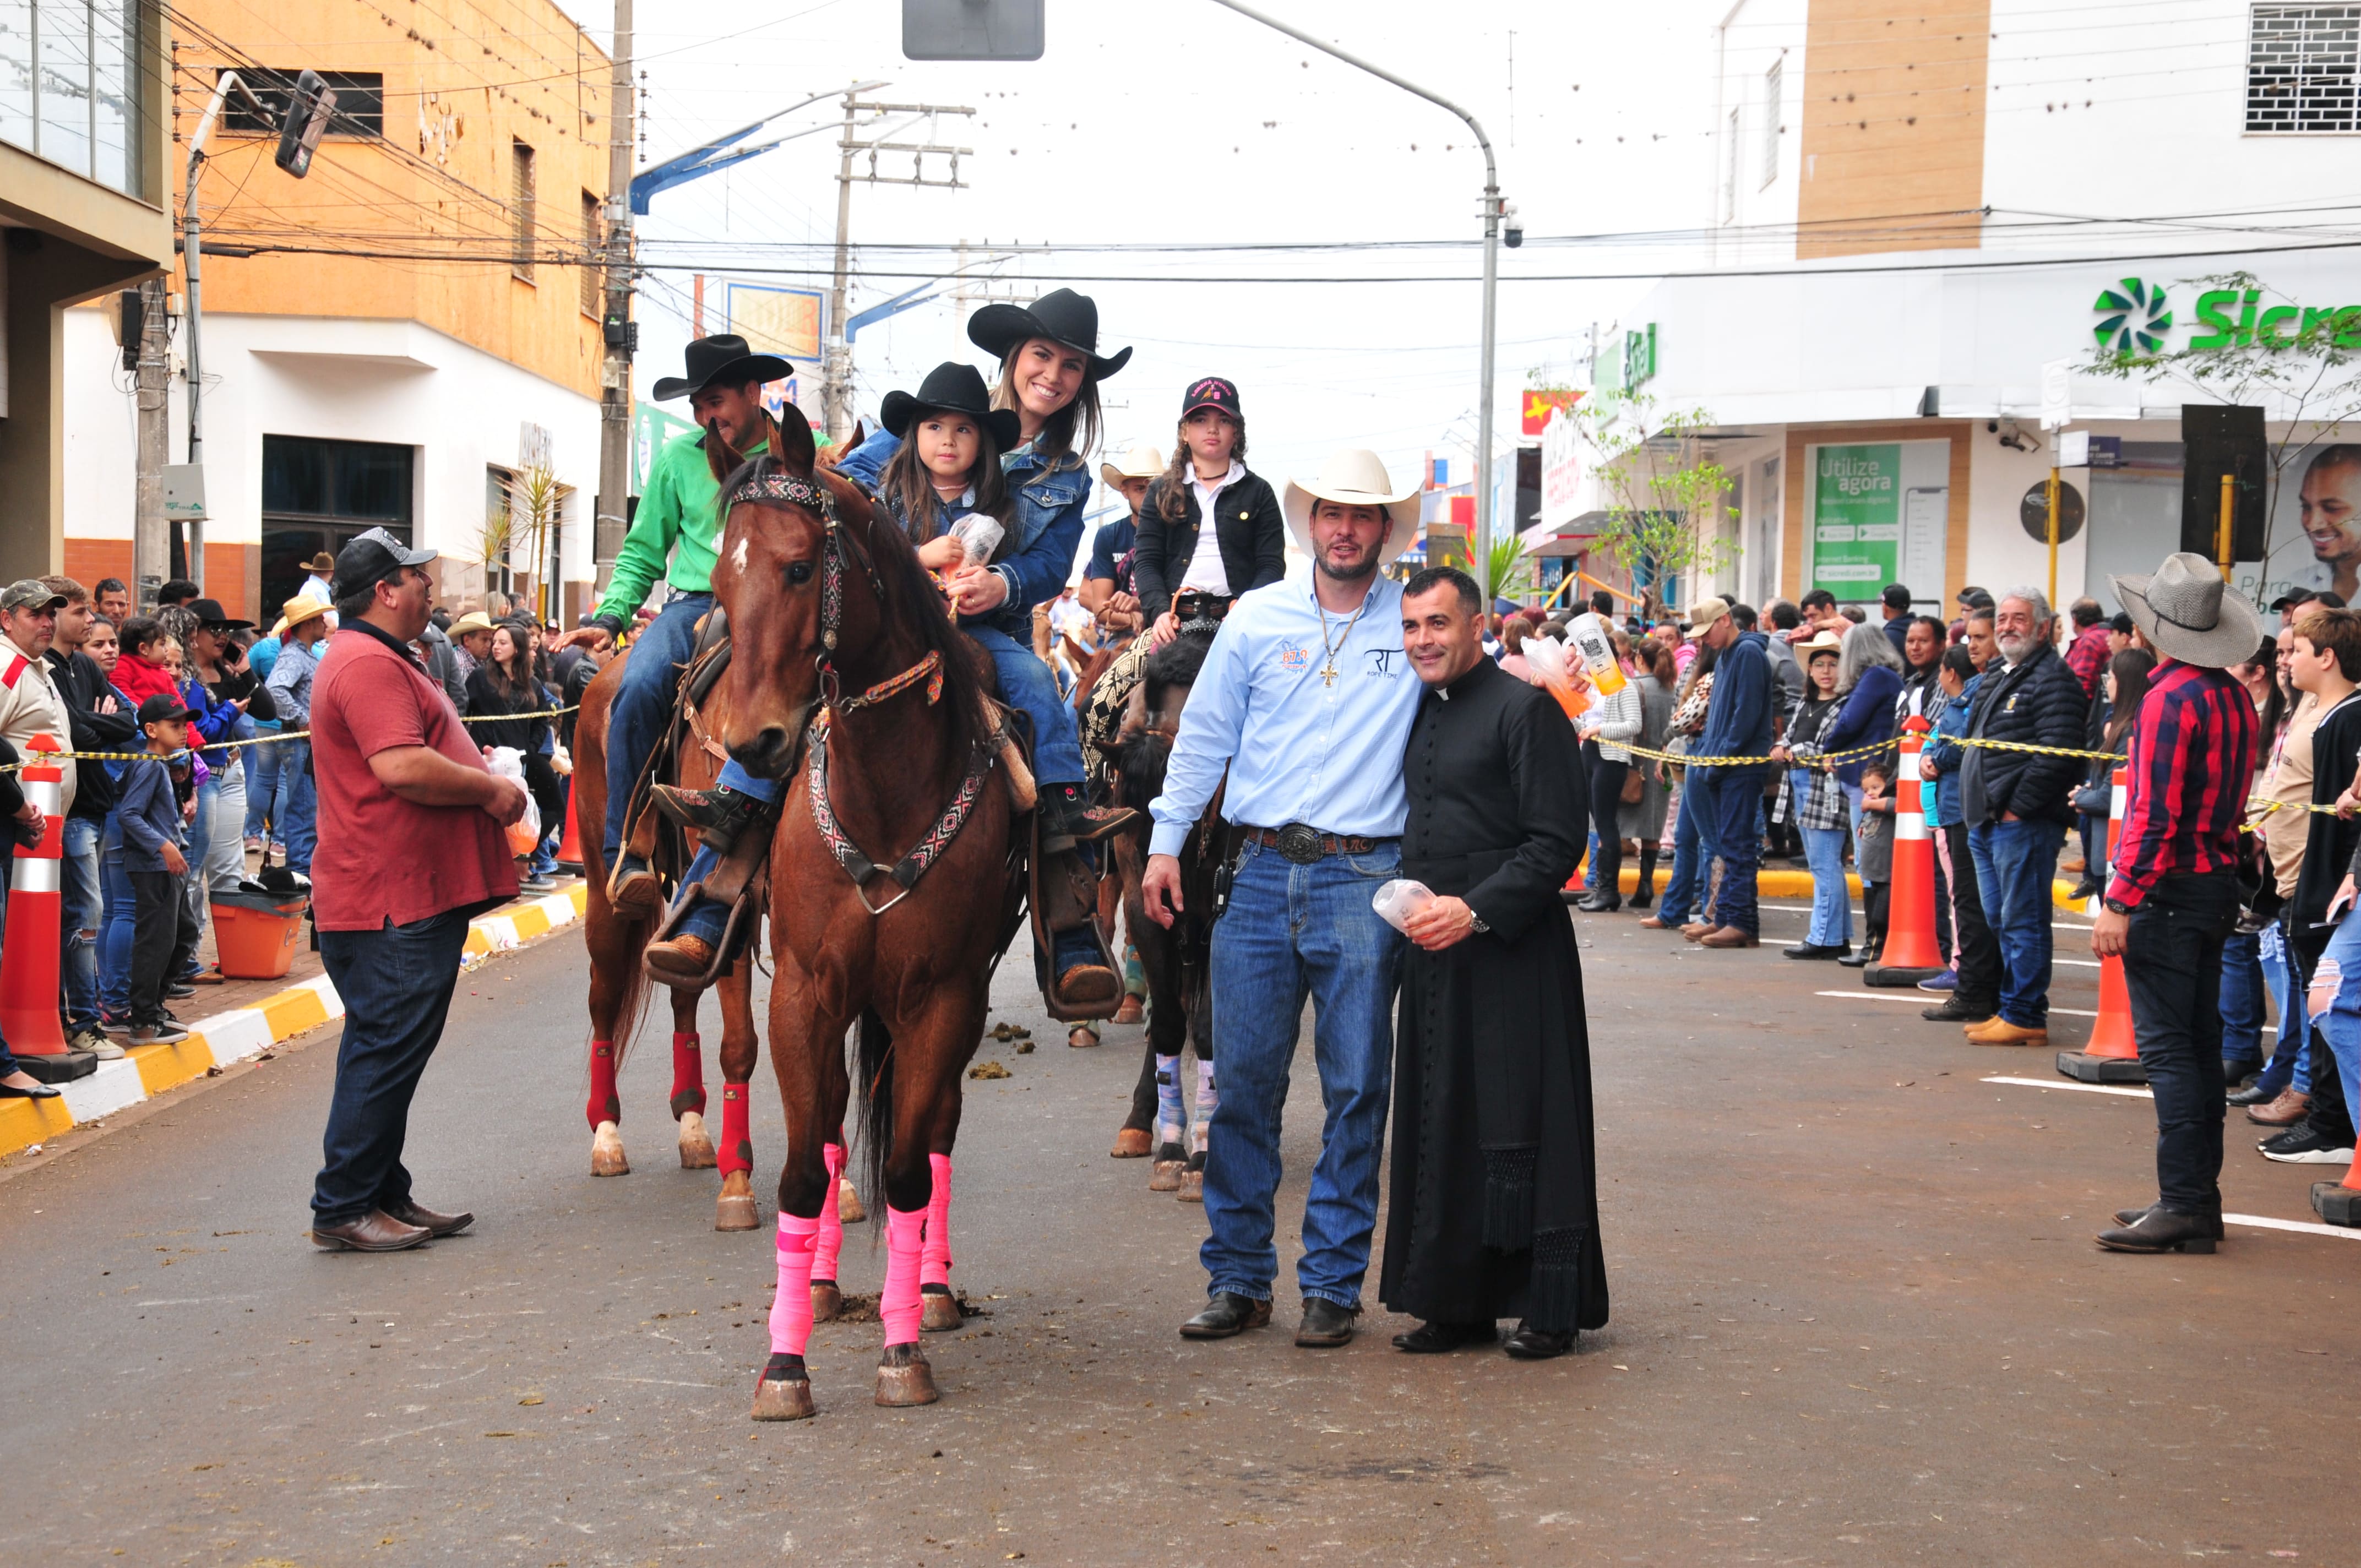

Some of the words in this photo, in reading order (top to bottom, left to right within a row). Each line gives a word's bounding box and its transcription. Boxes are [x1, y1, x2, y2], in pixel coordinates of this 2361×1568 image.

[1820, 458, 1879, 477] Utilize
[1838, 476, 1891, 495] agora
[1282, 649, 1308, 663] 87.9
